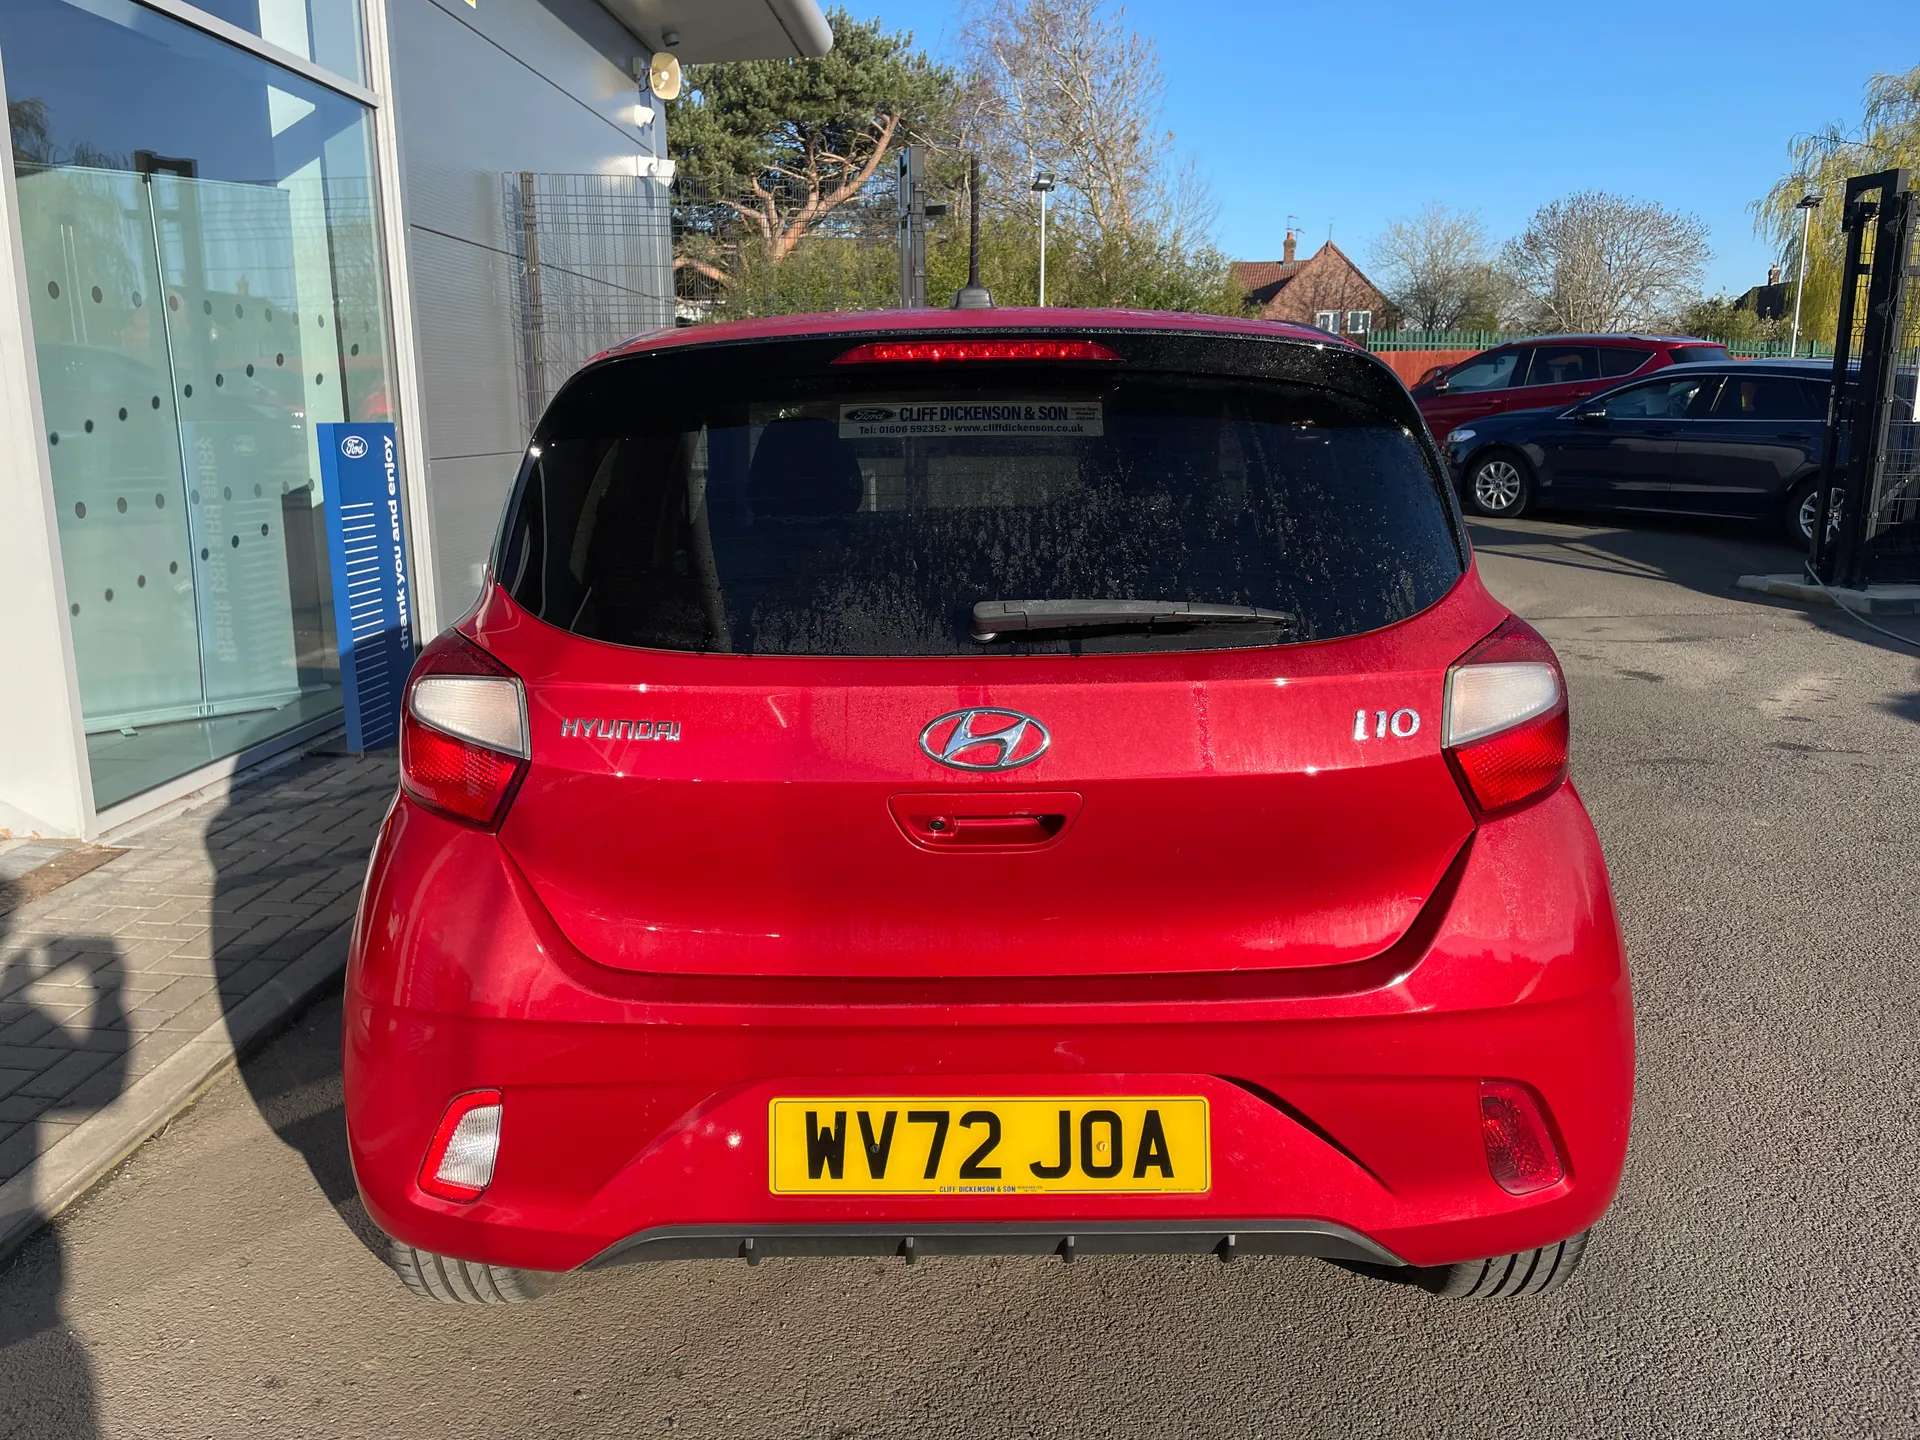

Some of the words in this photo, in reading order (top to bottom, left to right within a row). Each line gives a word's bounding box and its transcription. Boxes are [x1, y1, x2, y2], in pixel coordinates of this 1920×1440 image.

[900, 407, 938, 421] CLIFF
[939, 406, 1020, 421] DICKENSON
[1023, 406, 1036, 420] &
[1038, 406, 1068, 420] SON
[343, 437, 366, 456] Ford
[383, 435, 396, 496] enjoy
[387, 500, 400, 542] and
[393, 545, 405, 586] you
[396, 587, 409, 651] thank
[560, 718, 681, 741] HYUNDAI
[805, 1110, 1001, 1180] WV72
[1029, 1109, 1175, 1179] JOA
